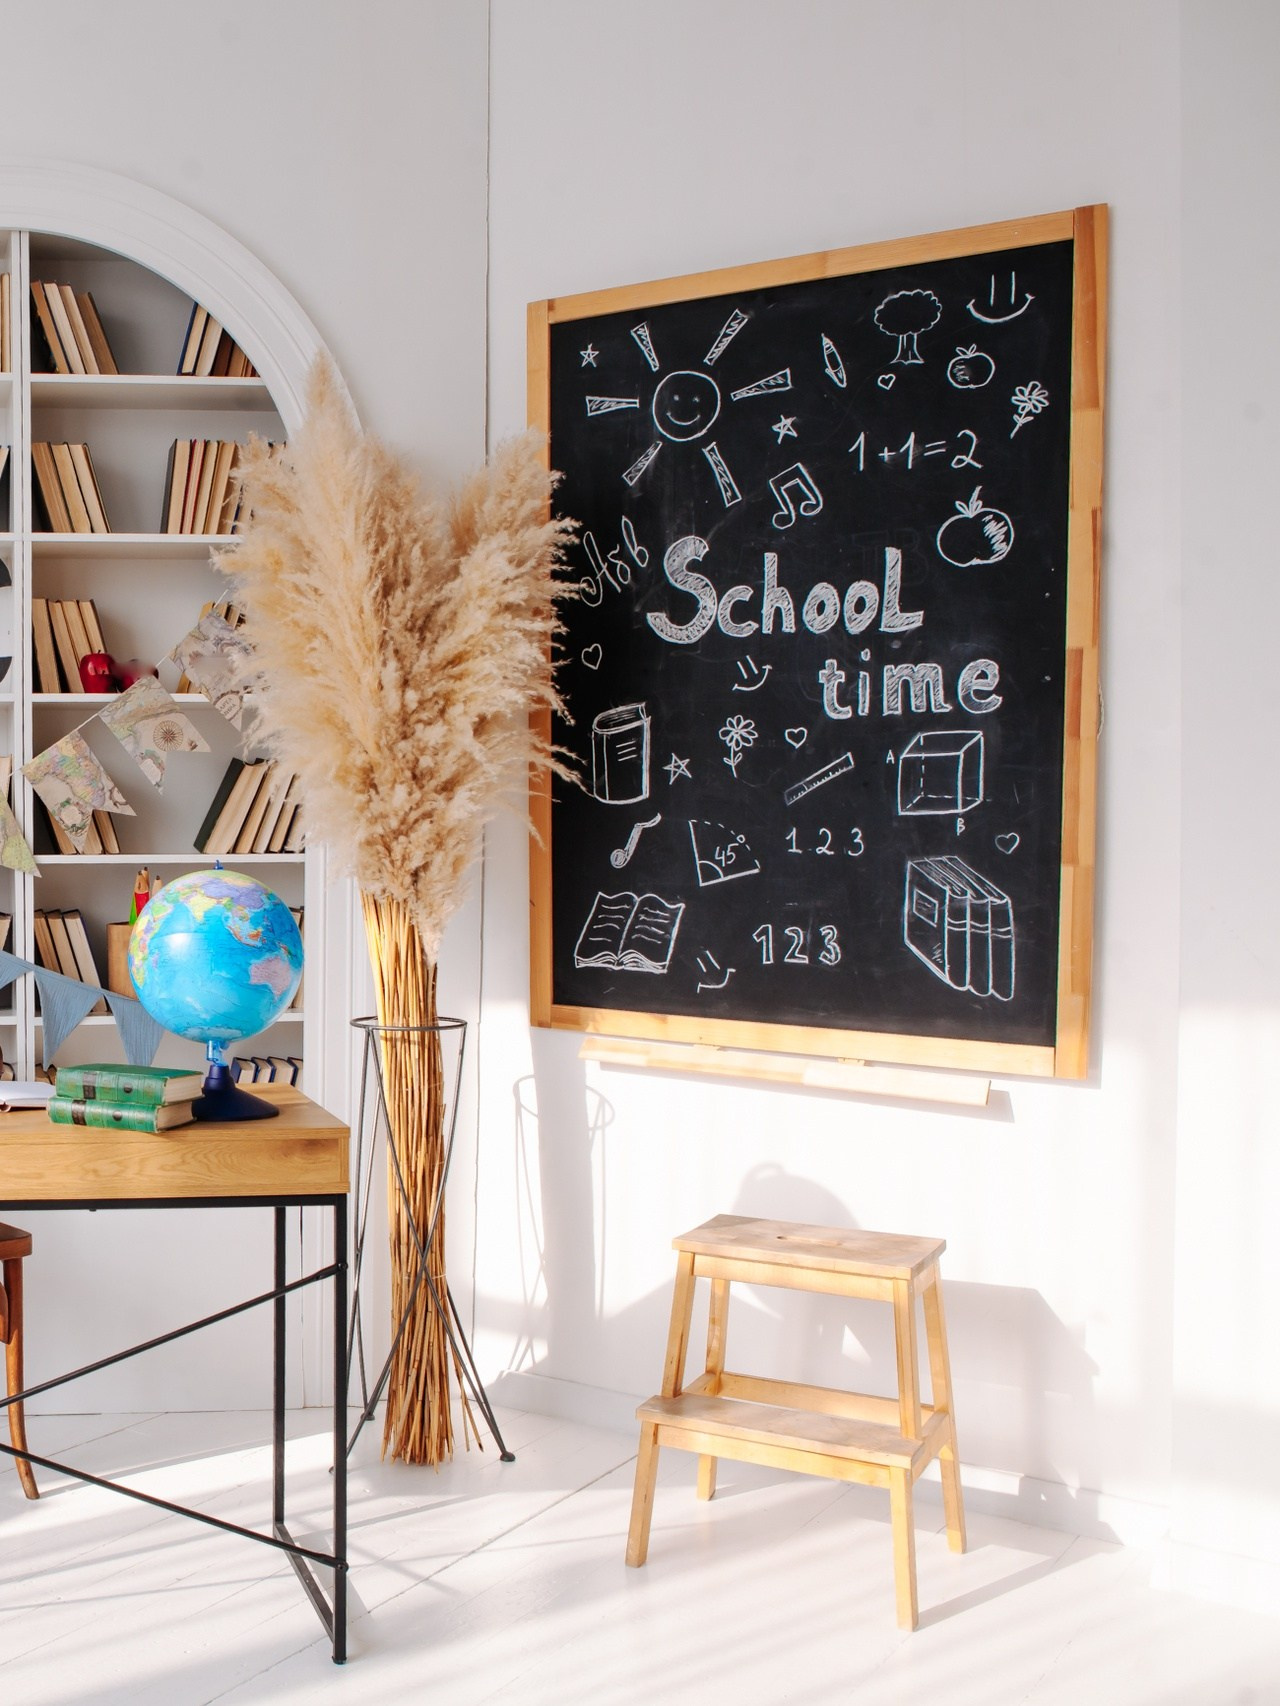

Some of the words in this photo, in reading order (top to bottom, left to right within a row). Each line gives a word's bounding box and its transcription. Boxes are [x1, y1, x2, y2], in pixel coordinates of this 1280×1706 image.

[818, 648, 1003, 720] time
[886, 749, 895, 765] A
[956, 817, 966, 836] B
